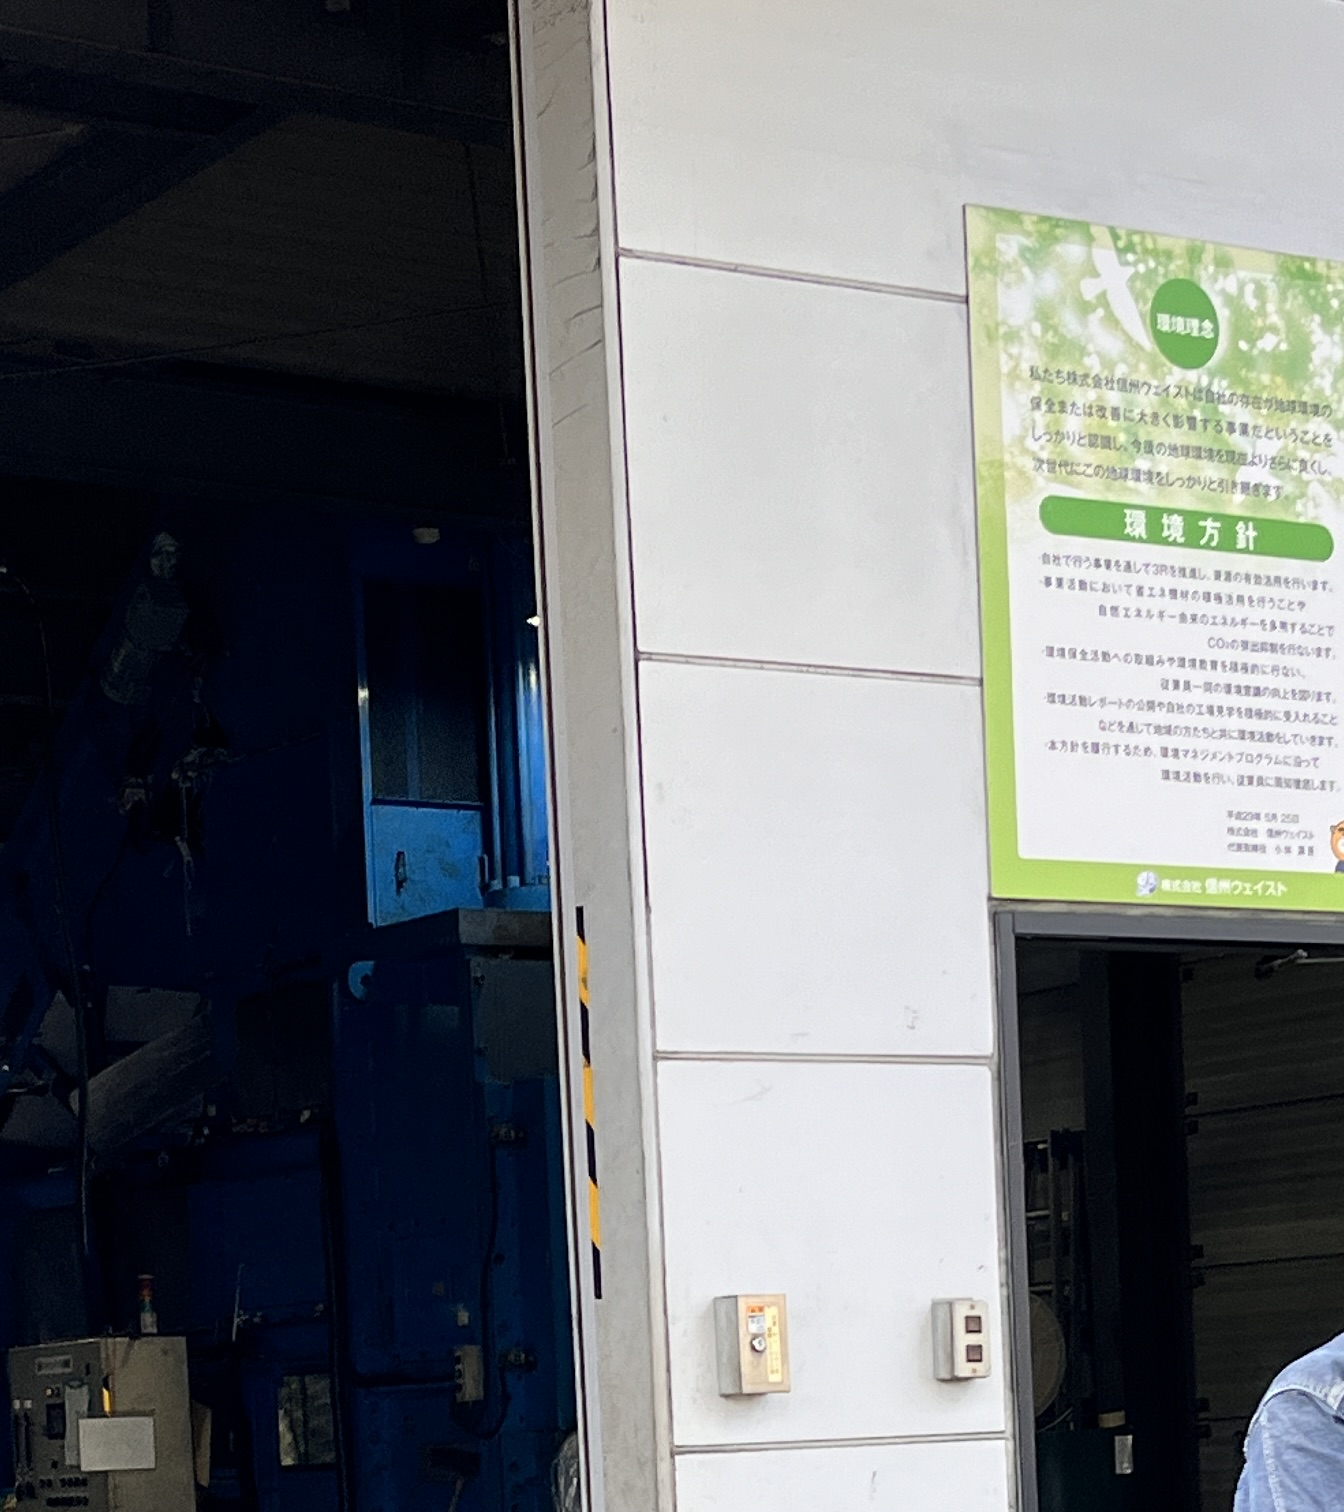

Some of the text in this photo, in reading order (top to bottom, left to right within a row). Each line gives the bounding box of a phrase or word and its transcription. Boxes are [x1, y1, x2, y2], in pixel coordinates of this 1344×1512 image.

[1156, 313, 1215, 338] 環境理念
[1123, 509, 1258, 551] 環境方針
[1161, 878, 1287, 897] 株式会社 信州ウェイスト
